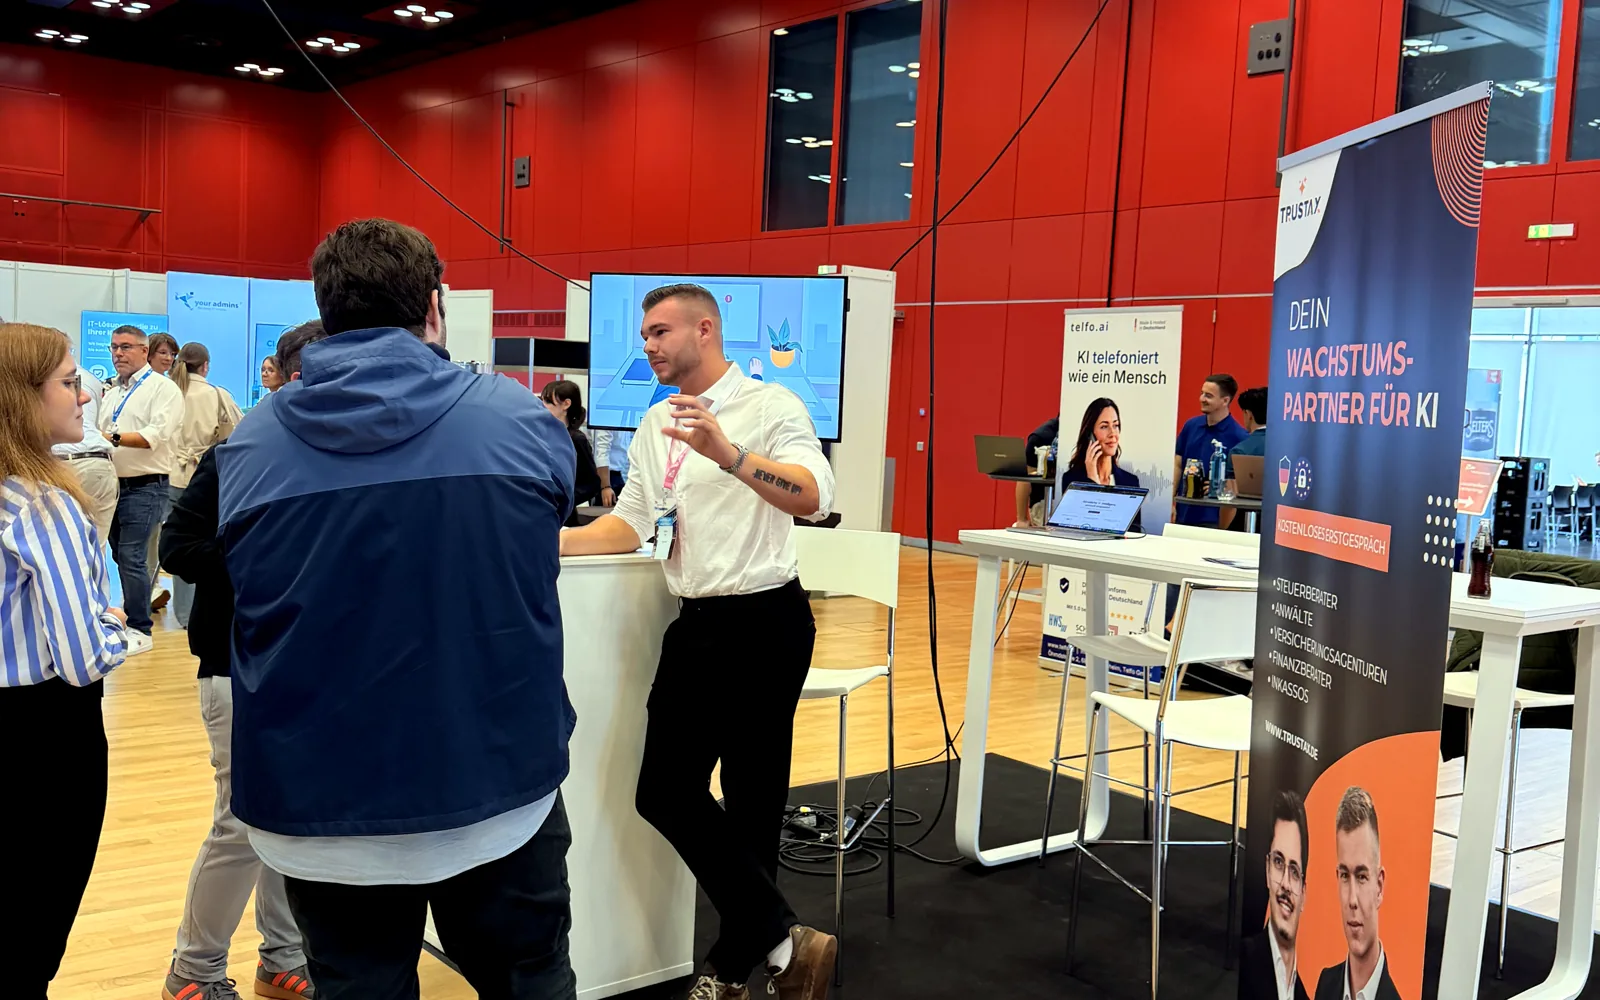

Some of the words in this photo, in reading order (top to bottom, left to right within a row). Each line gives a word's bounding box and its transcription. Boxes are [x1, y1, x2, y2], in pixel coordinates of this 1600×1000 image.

[213, 301, 239, 309] admins
[1289, 296, 1330, 331] DEIN
[1070, 321, 1109, 332] telfo.ai
[1077, 350, 1090, 364] KI
[1092, 350, 1159, 365] telefoniert
[1287, 340, 1414, 378] WACHSTUMS-
[1068, 369, 1089, 383] wie
[1091, 369, 1111, 383] ein
[1113, 369, 1167, 384] Mensch
[1283, 392, 1365, 425] PARTNER
[1369, 383, 1411, 427] FÜR
[1415, 392, 1439, 429] KI
[1276, 577, 1339, 610] STEUERBERATER
[1275, 602, 1314, 627] ANWÄLTE
[1272, 650, 1333, 690] FINANZBERATER
[1273, 626, 1388, 686] VERSICHERUNGSAGENTUREN
[1271, 675, 1310, 703] INKASSOS
